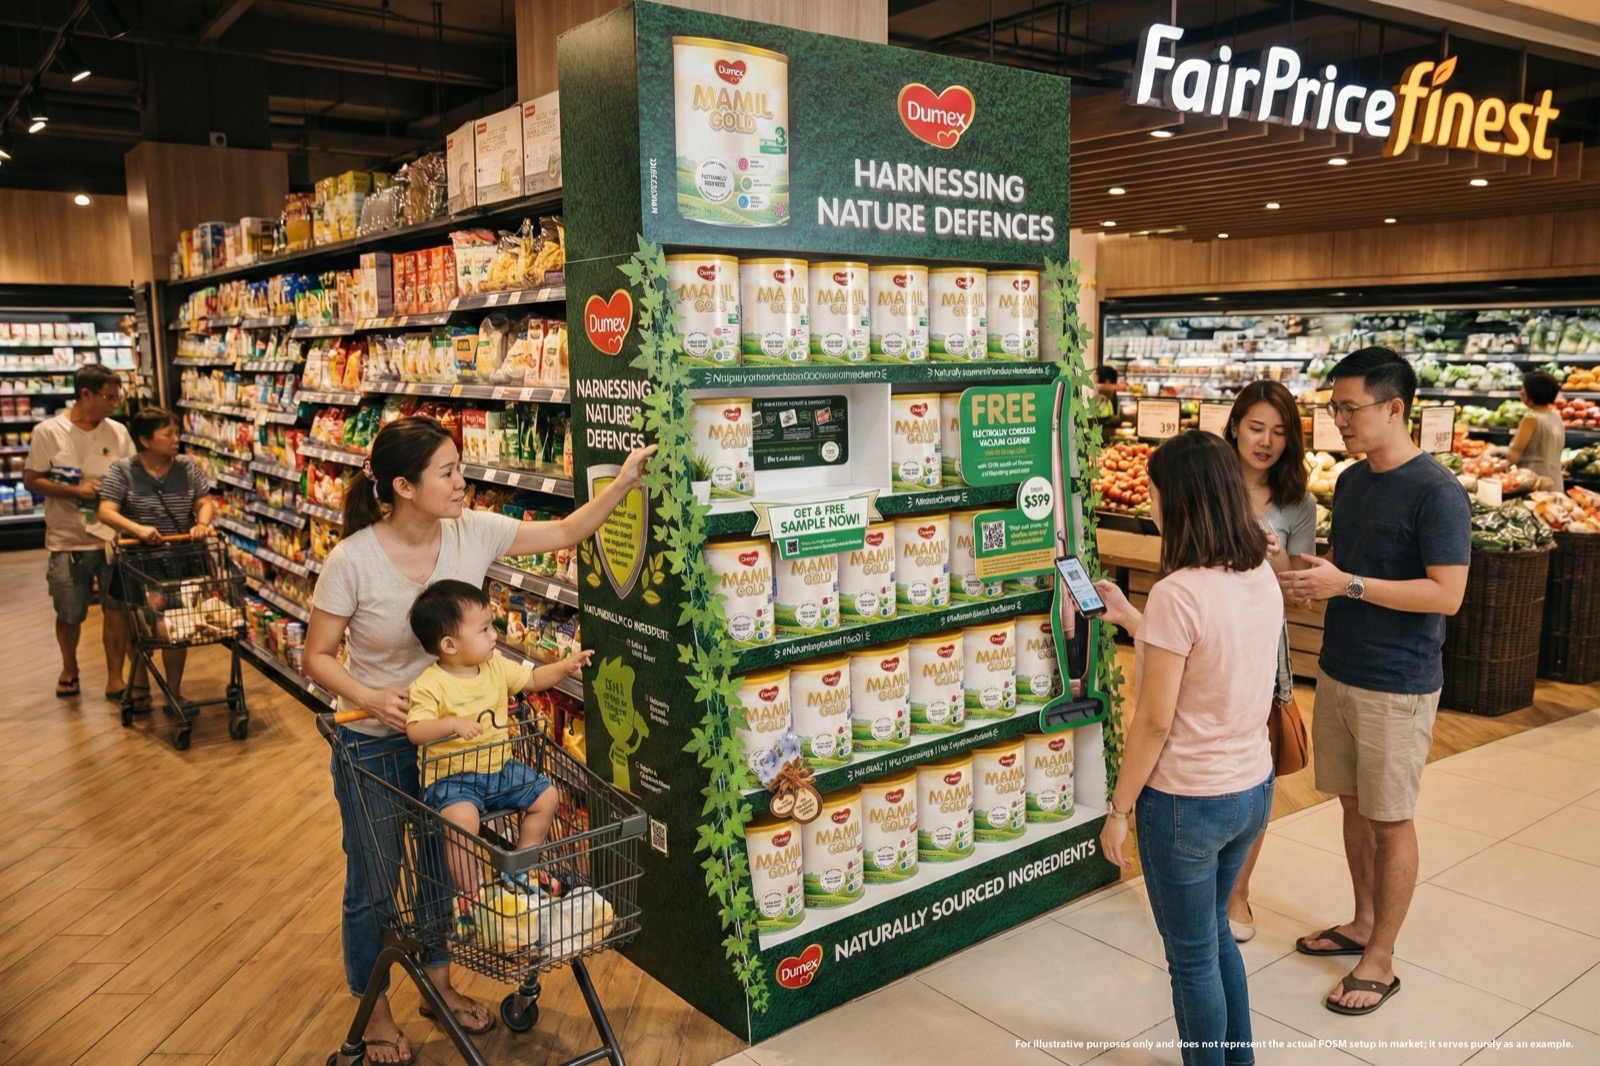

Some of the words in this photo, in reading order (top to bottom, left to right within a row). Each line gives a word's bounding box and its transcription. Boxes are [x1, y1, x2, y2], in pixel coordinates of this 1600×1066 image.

[692, 85, 773, 117] MAMIL
[709, 110, 756, 132] GOLD
[907, 100, 967, 129] Dumex
[854, 158, 1025, 203] HARNESSING
[817, 196, 926, 233] NATURE
[934, 206, 1055, 242] DEFENCES
[589, 314, 626, 333] Dumex
[576, 378, 652, 400] NARNESSING
[971, 392, 1036, 426] FREE
[586, 428, 646, 452] DEFENCES
[794, 506, 812, 518] GET
[814, 506, 822, 516] &
[824, 503, 846, 514] FREE
[780, 518, 826, 534] SAMPLE
[828, 513, 860, 526] NOW!
[834, 909, 928, 962] NATURALLY
[932, 876, 1005, 922] SOURCED
[1008, 838, 1096, 890] INGREDIENTS
[781, 958, 818, 981] Dumex
